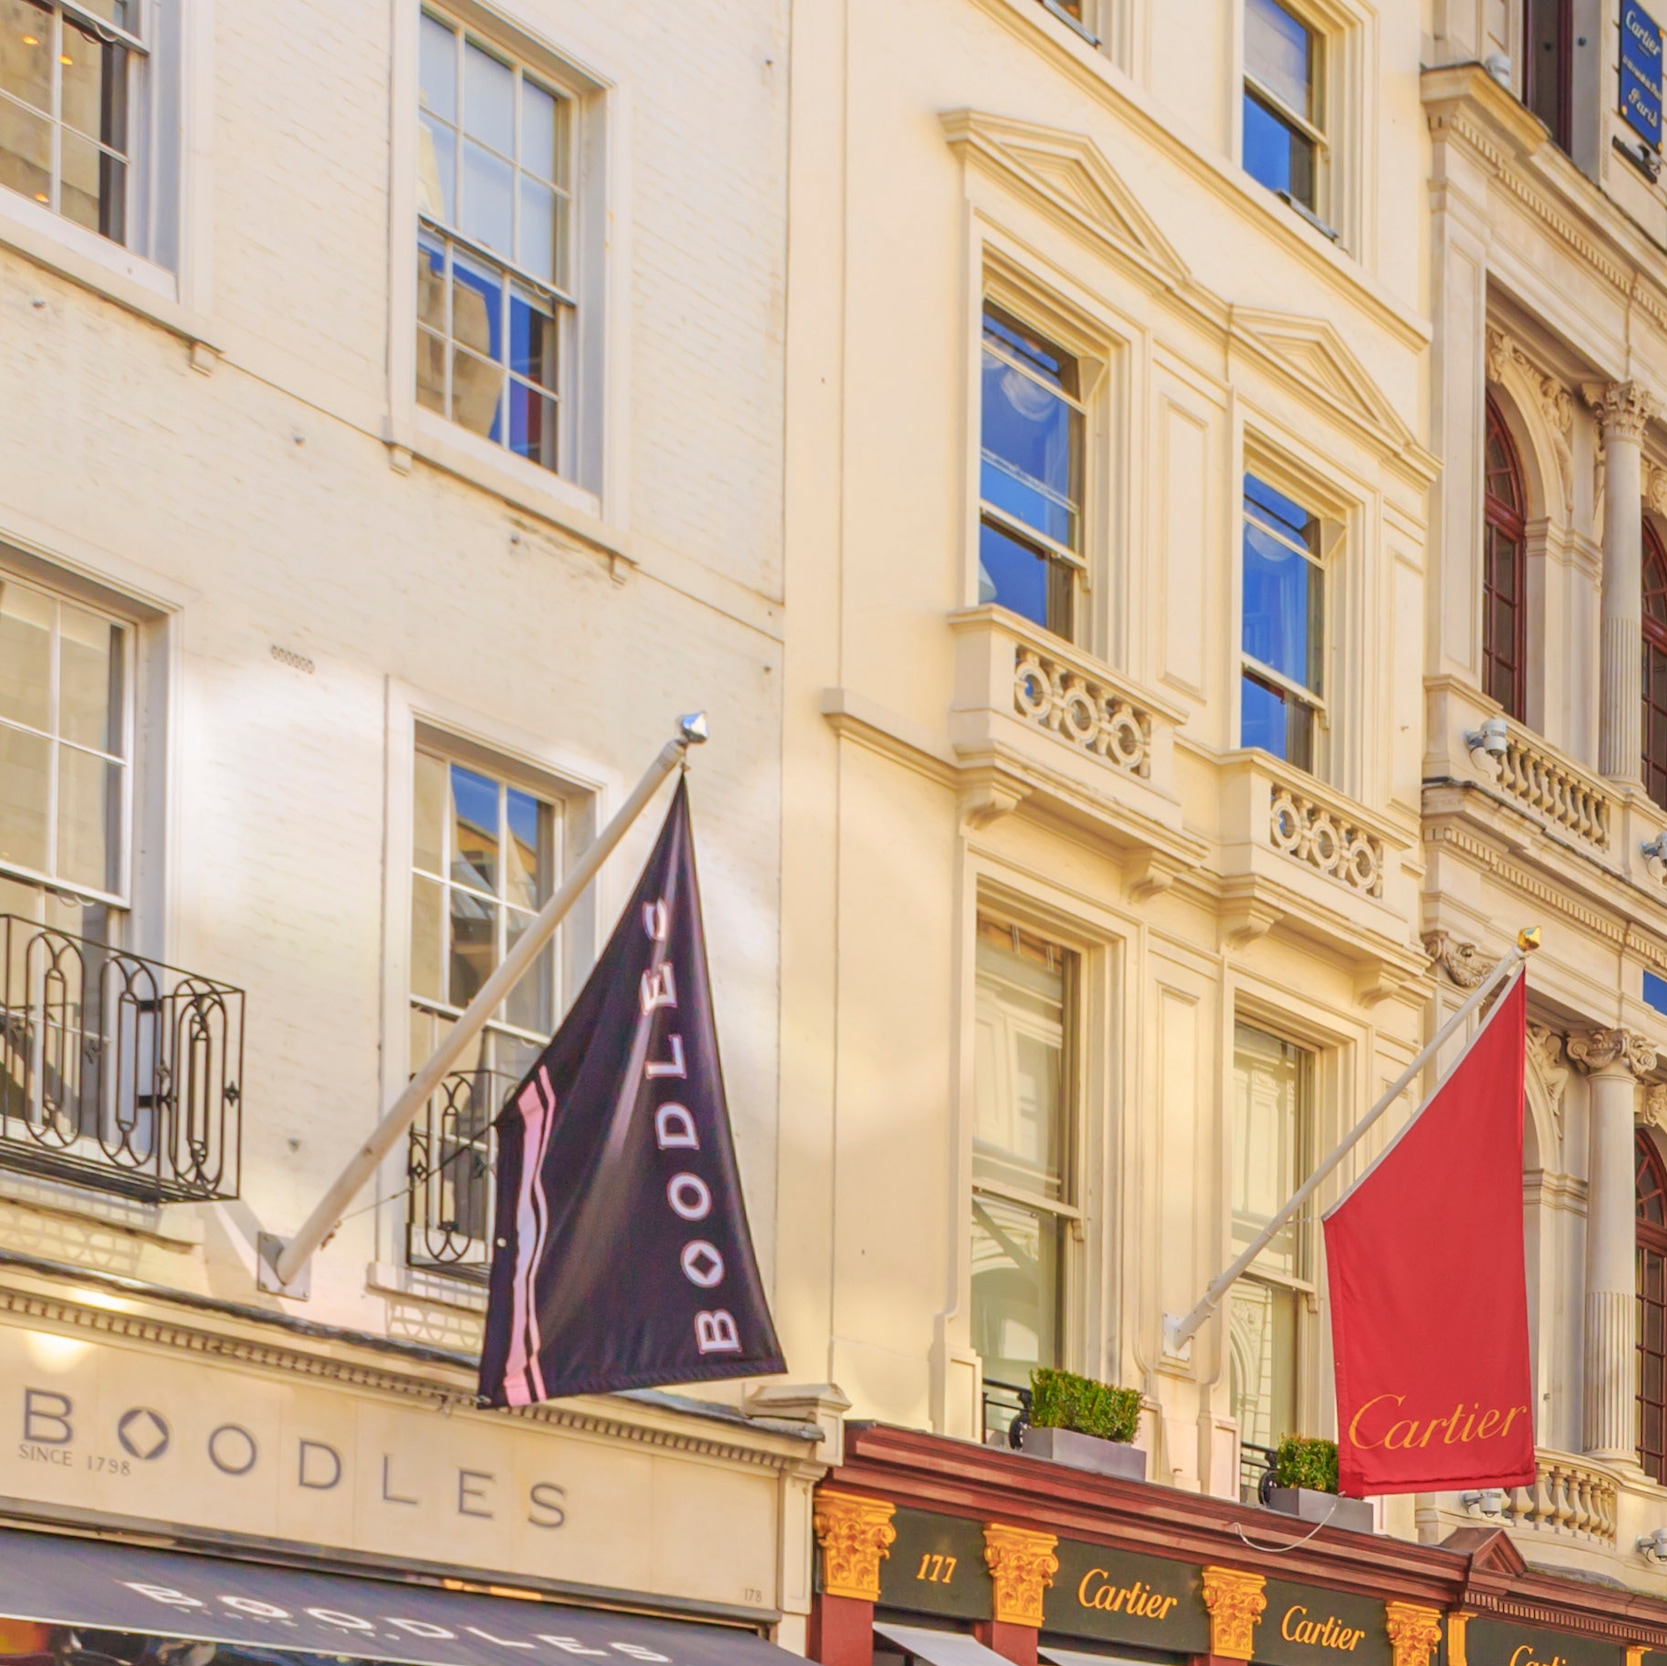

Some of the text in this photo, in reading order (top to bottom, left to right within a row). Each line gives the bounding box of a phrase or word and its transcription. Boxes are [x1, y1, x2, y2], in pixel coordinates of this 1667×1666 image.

[1626, 10, 1661, 56] Cartier
[1348, 1393, 1528, 1451] Cartier
[19, 1443, 132, 1476] SINCE 1798
[22, 1386, 568, 1529] BOODLES
[915, 1553, 958, 1585] 177
[743, 1588, 763, 1604] 178
[1077, 1568, 1178, 1621] Cartier
[117, 1579, 673, 1663] BOODLES
[1280, 1605, 1366, 1652] Cartier
